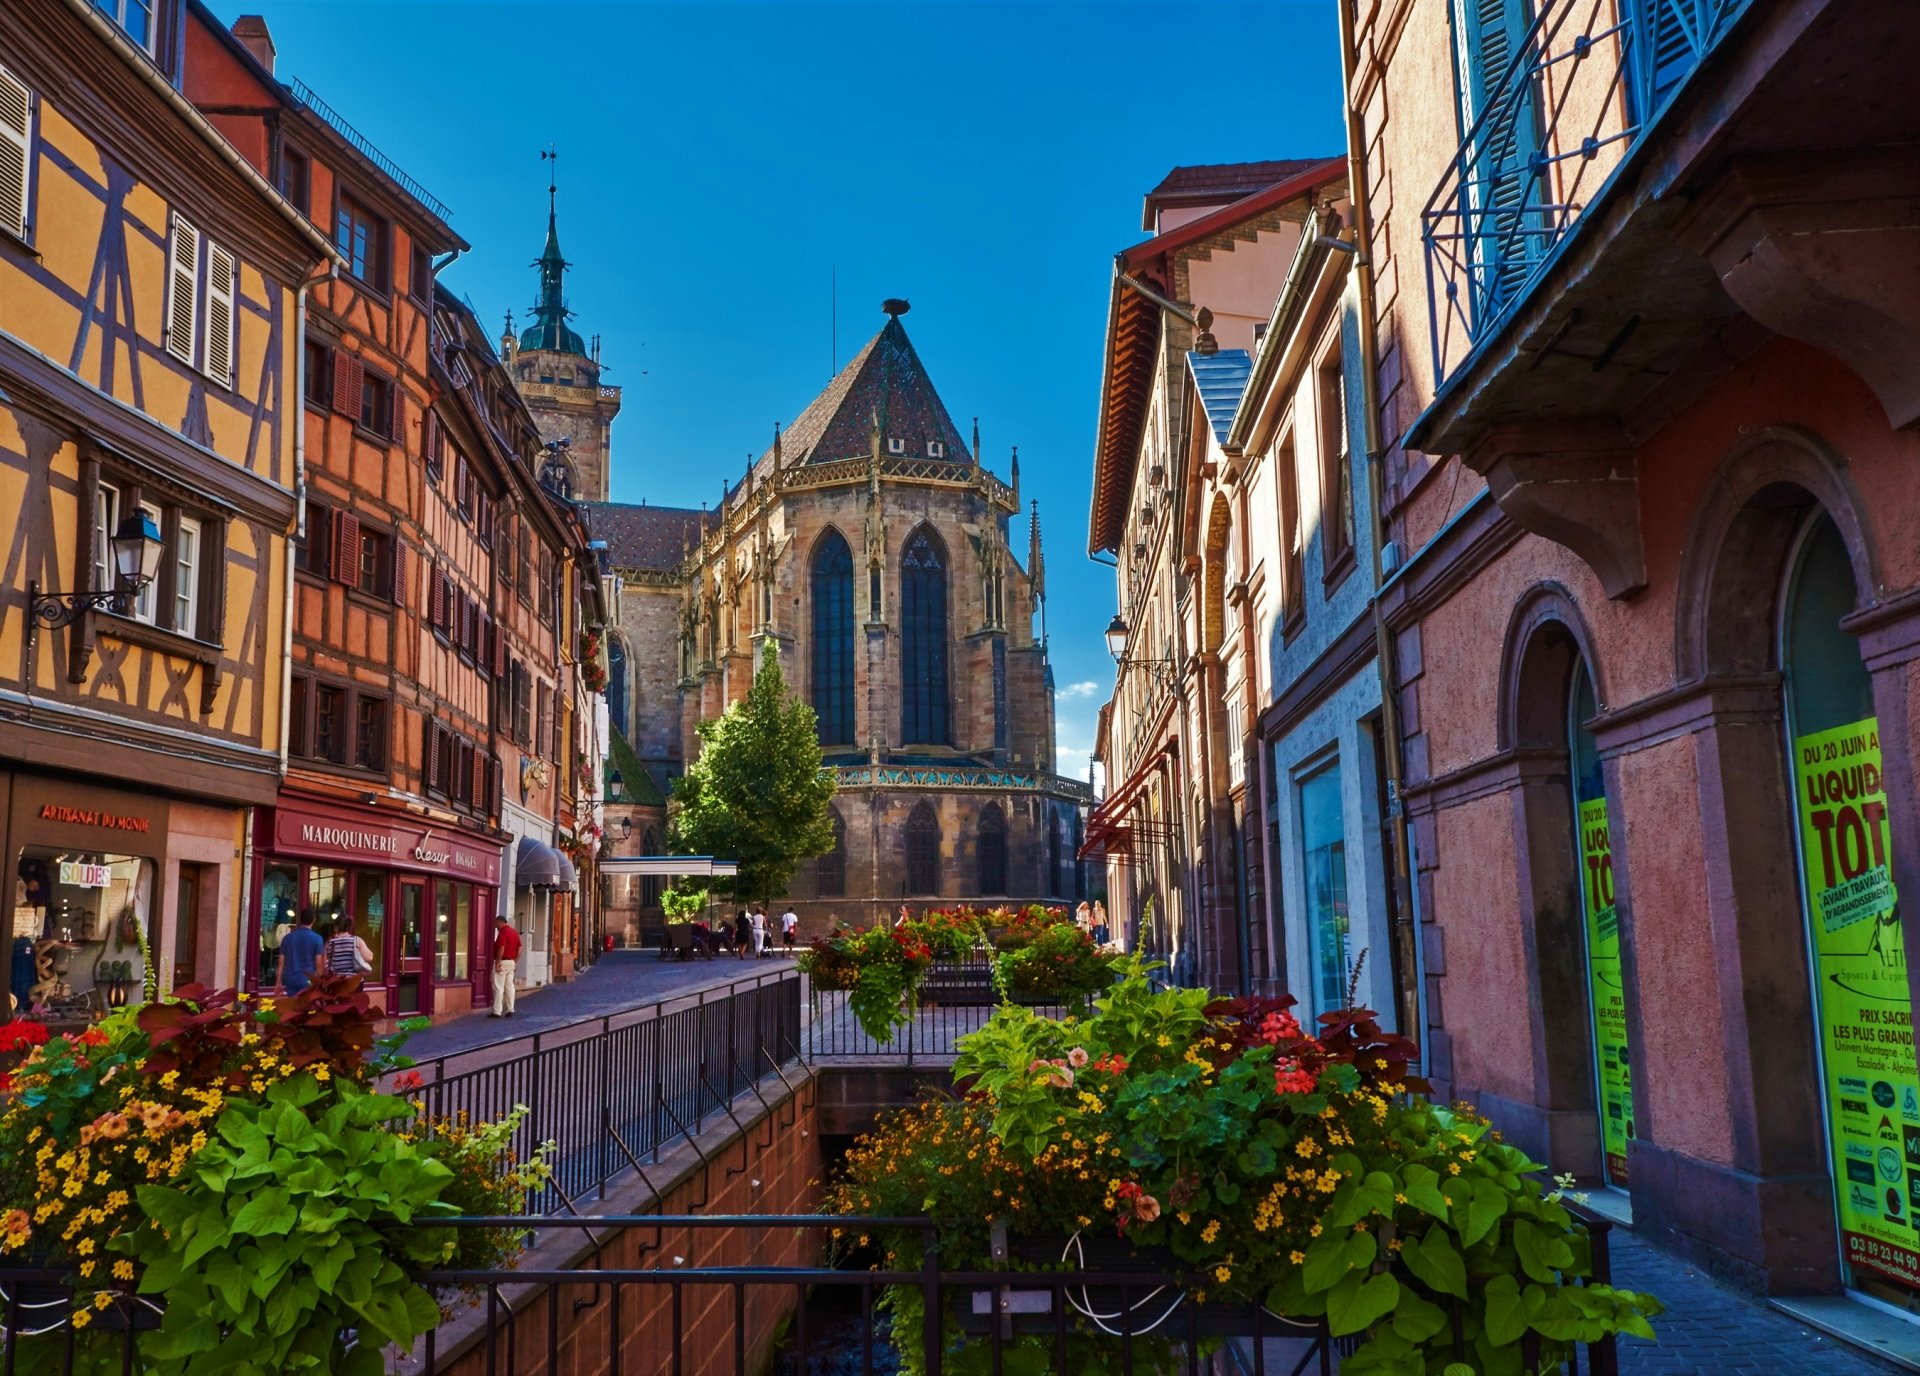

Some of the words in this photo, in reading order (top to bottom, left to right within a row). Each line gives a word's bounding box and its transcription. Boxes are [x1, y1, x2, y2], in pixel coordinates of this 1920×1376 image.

[1803, 745, 1821, 766] DU
[1823, 741, 1838, 761] 20
[1840, 734, 1867, 758] JUIN
[1806, 762, 1884, 806] LIQUID
[41, 803, 101, 826] ARTISANAT
[102, 811, 116, 829] DU
[117, 815, 150, 833] MONDE
[302, 823, 398, 854] MAROQUINERIE
[1810, 800, 1895, 889] TOT
[61, 863, 110, 885] SOLDES
[1823, 886, 1850, 908] AVANT
[1849, 869, 1887, 896] TRAVAUX
[1859, 1008, 1881, 1024] PRIX
[1833, 1024, 1851, 1040] LES
[1852, 1026, 1875, 1042] PLUS
[1850, 1236, 1866, 1252] 03
[1867, 1241, 1879, 1257] 89
[1880, 1245, 1892, 1261] 23
[1893, 1249, 1905, 1266] 44
[1906, 1254, 1918, 1271] 90
